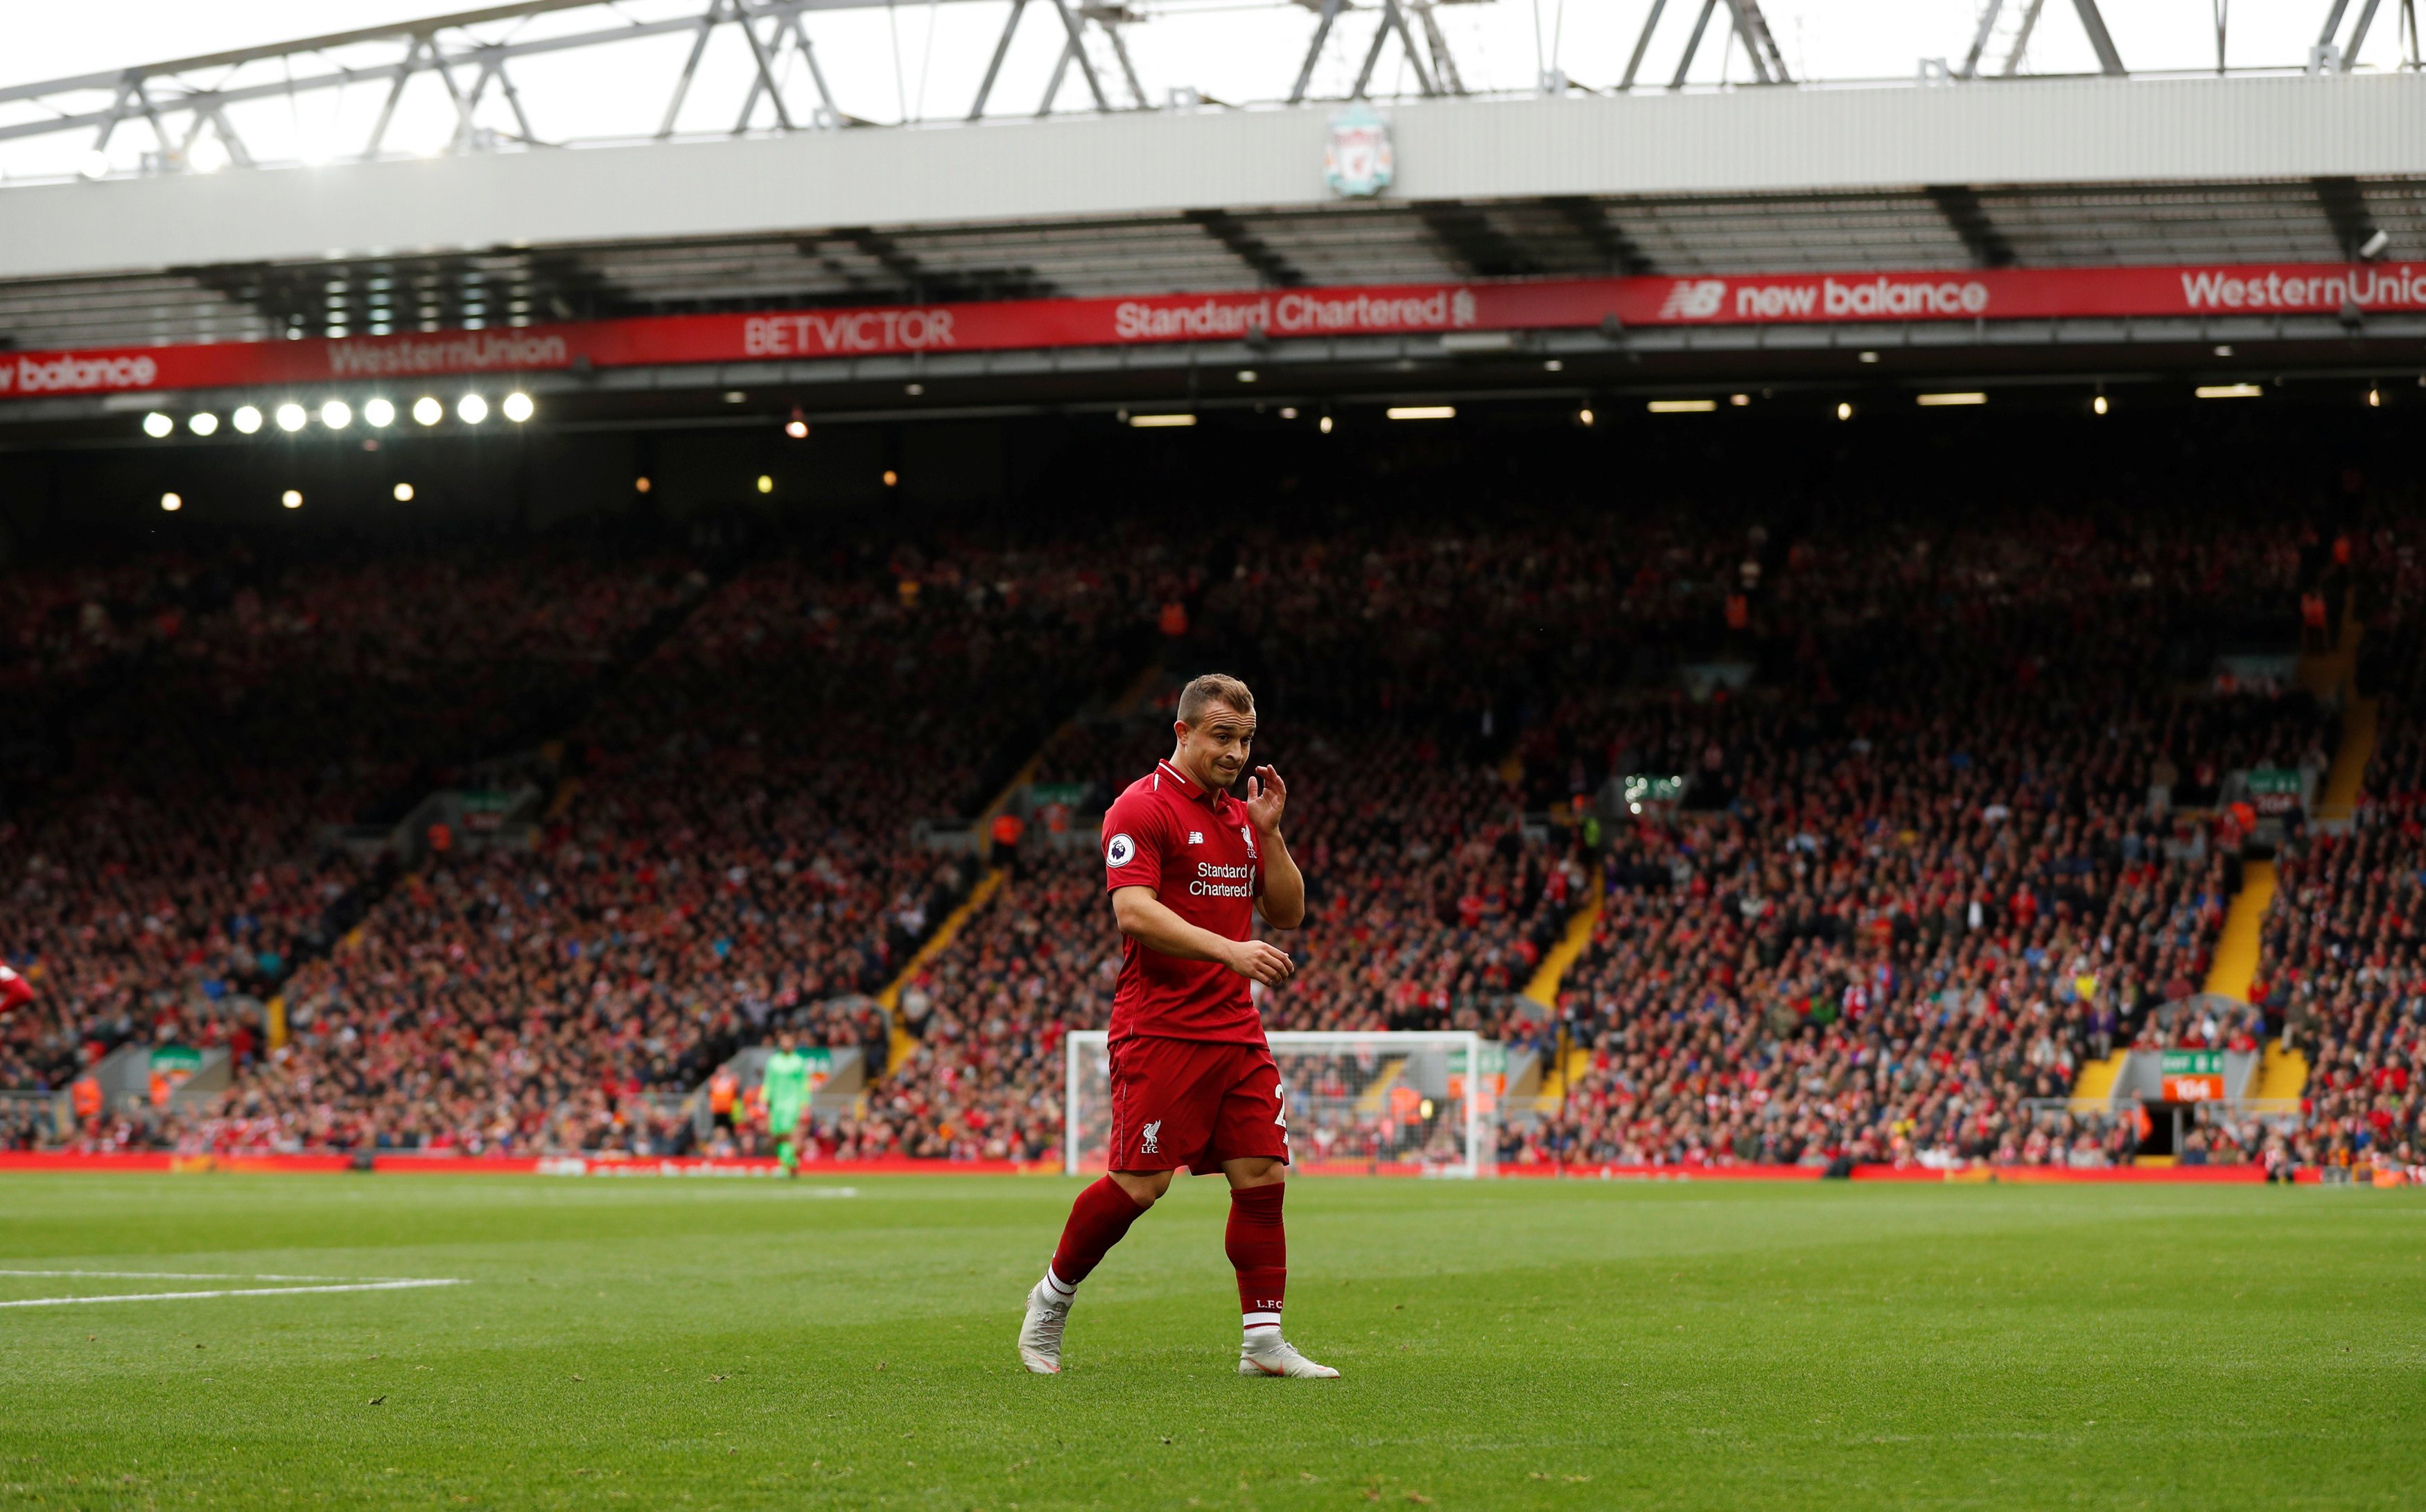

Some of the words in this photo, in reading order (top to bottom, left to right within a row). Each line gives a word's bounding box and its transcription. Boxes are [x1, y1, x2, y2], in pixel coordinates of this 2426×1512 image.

[1115, 299, 1269, 337] Standard
[1276, 290, 1446, 329] Chartered
[1736, 285, 1817, 317] new
[1824, 277, 1987, 316] balance
[744, 310, 955, 356] BETVICTOR
[18, 355, 157, 392] balance
[1189, 880, 1247, 897] Chartered
[1198, 862, 1247, 879] Standard
